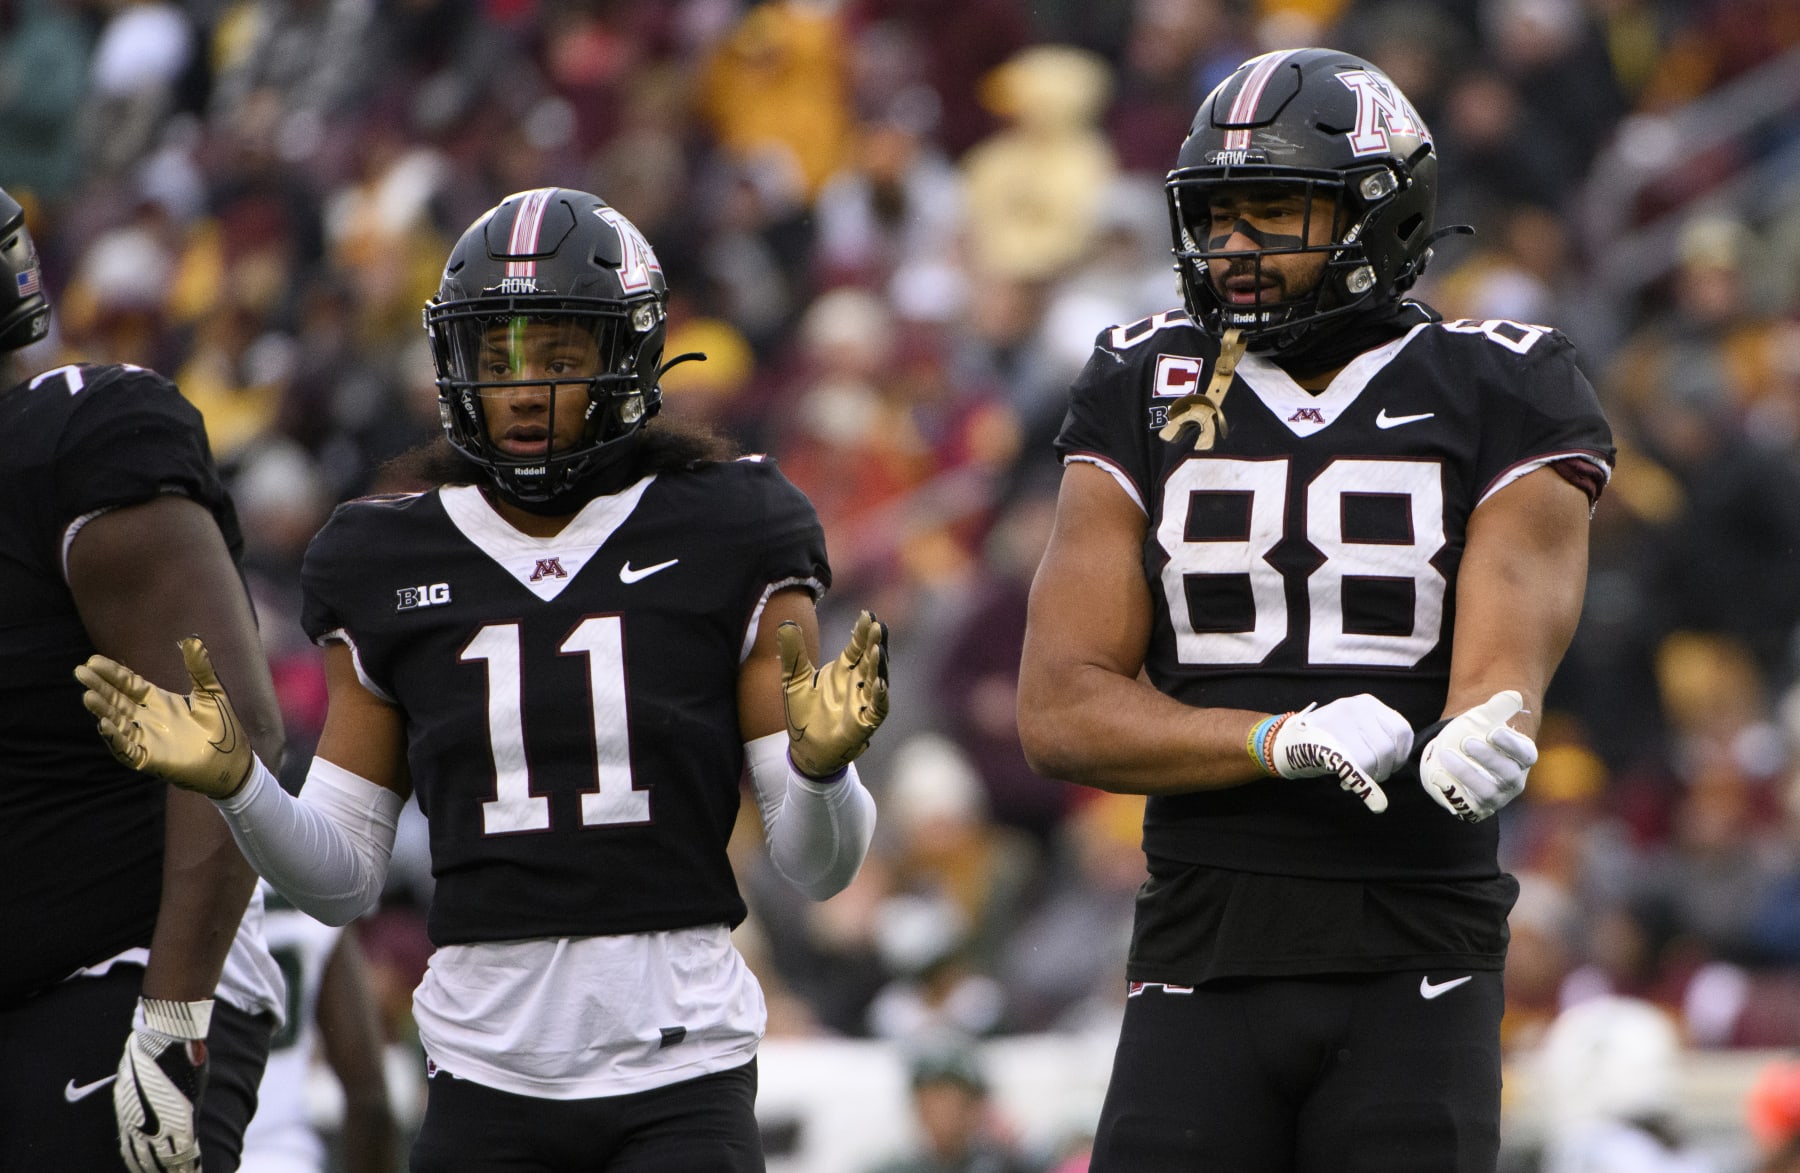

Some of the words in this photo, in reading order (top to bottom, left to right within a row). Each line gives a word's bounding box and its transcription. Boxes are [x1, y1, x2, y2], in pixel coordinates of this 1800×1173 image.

[502, 278, 536, 293] ROW
[1233, 312, 1270, 323] Riddll
[1156, 357, 1200, 396] C
[1288, 408, 1325, 424] M
[514, 467, 546, 476] Riddell
[530, 557, 568, 583] M
[1156, 454, 1448, 671] 88
[456, 611, 655, 838] 11
[1285, 743, 1373, 801] MINNESOTA
